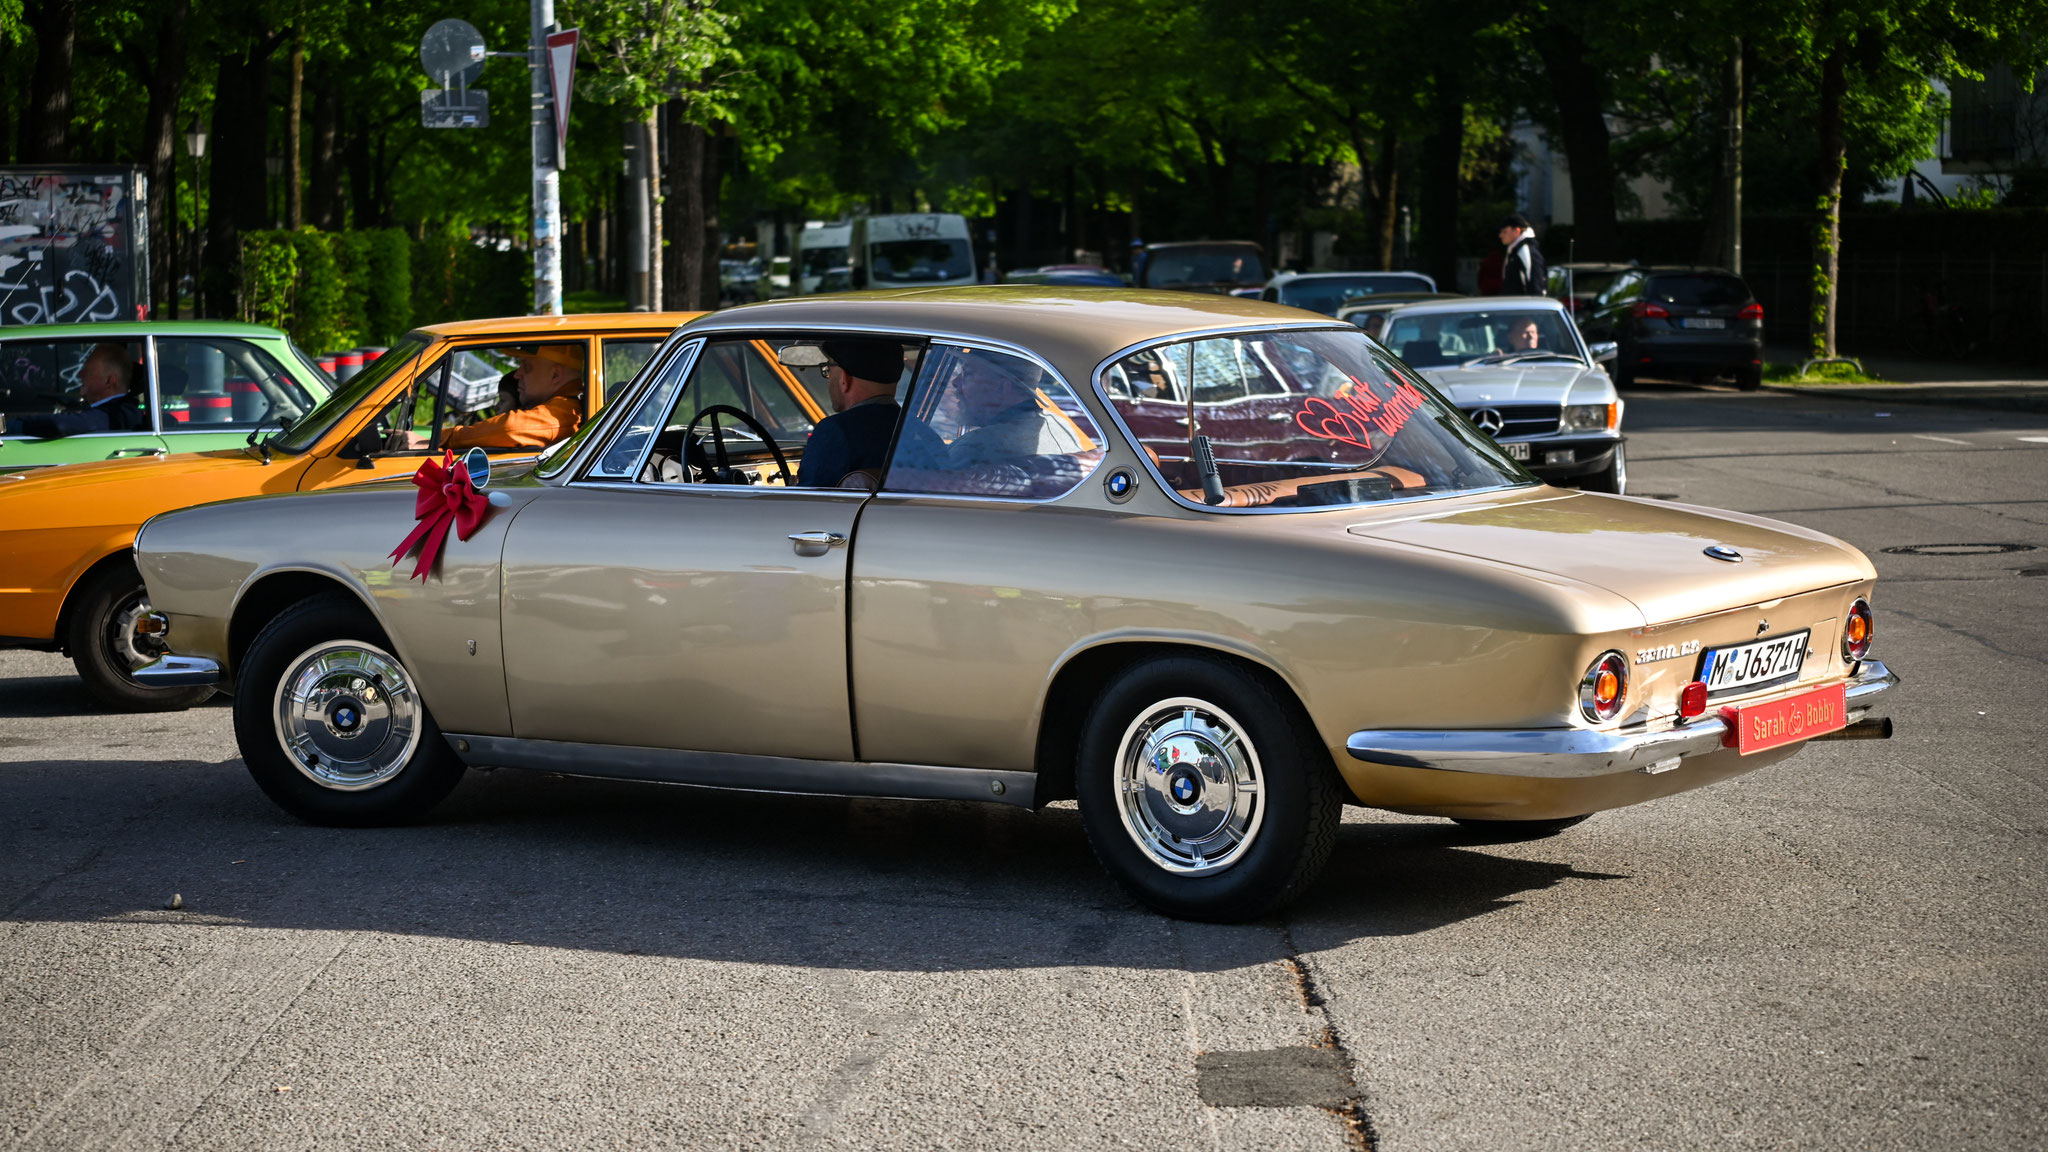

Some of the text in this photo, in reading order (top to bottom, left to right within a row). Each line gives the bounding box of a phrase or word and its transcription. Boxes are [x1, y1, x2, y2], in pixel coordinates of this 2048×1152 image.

[1710, 653, 1729, 686] M
[1753, 710, 1785, 741] Sarah
[1806, 698, 1835, 726] Bobby
